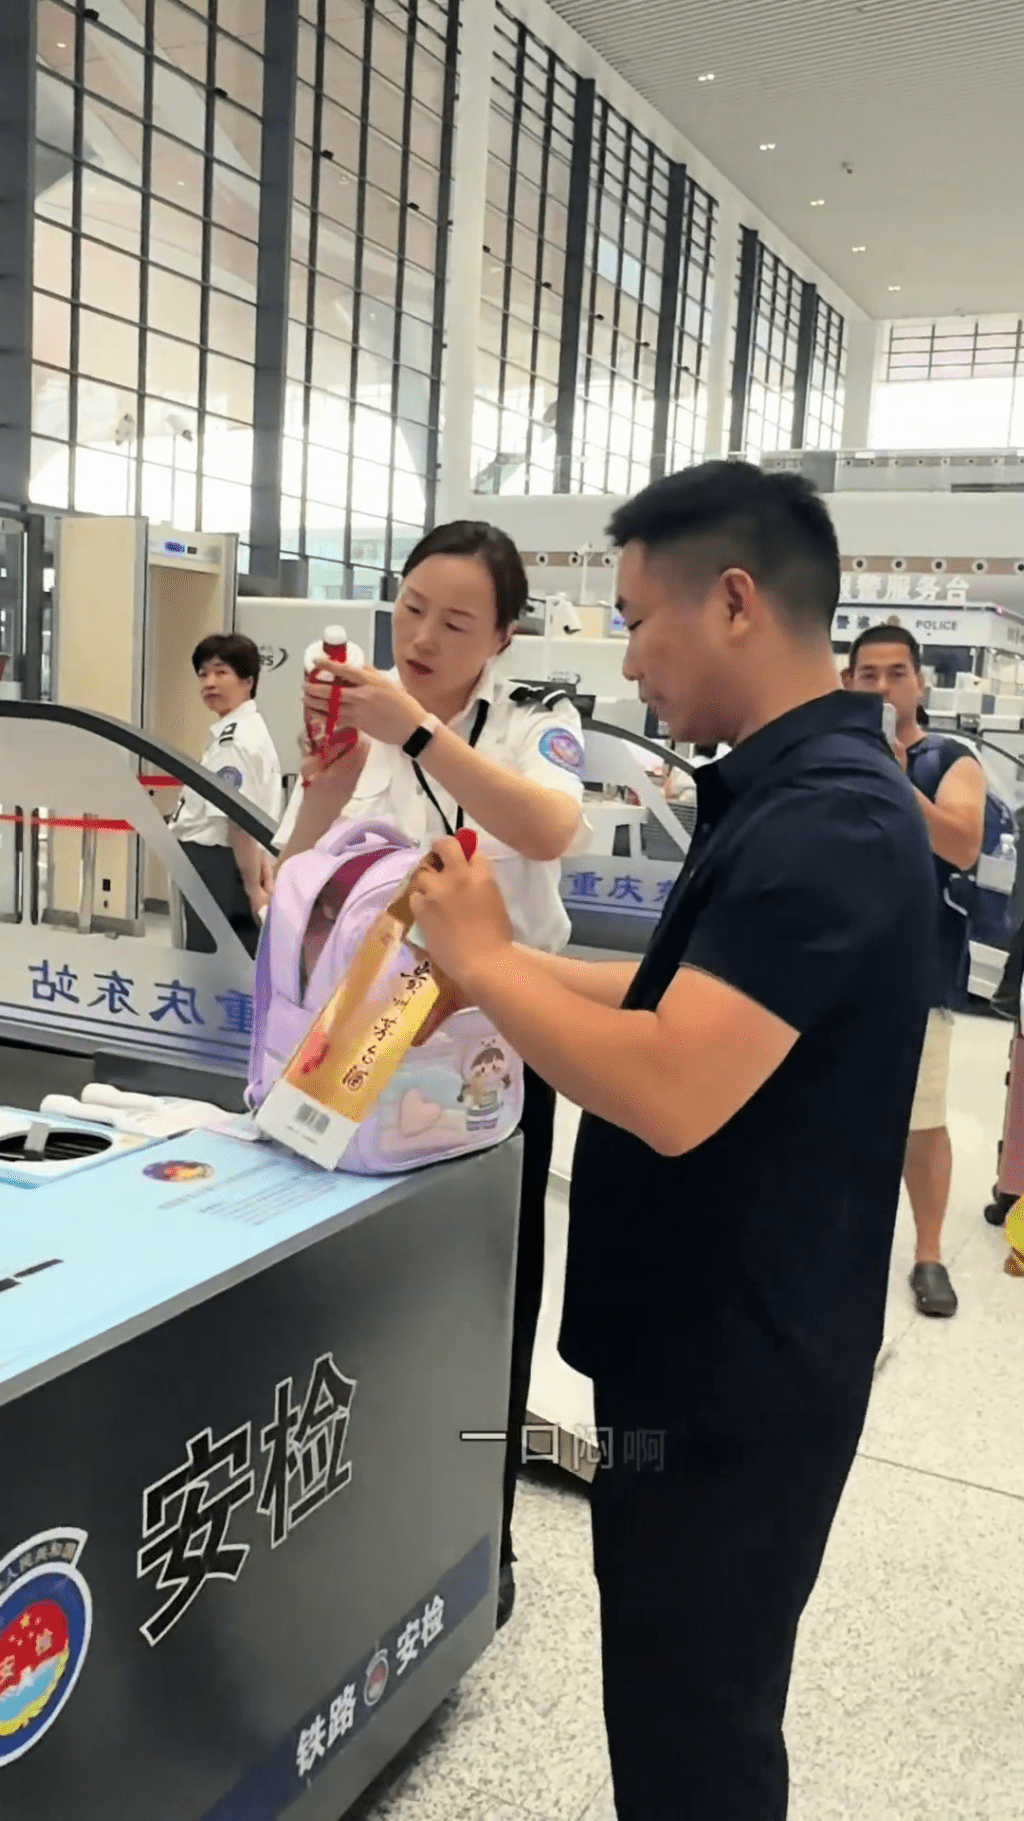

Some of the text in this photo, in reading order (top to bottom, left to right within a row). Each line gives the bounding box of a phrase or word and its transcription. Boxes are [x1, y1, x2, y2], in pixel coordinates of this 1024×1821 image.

[915, 619, 958, 631] POLICE
[137, 1351, 357, 1647] 安检
[296, 1594, 445, 1777] 铁路 安检
